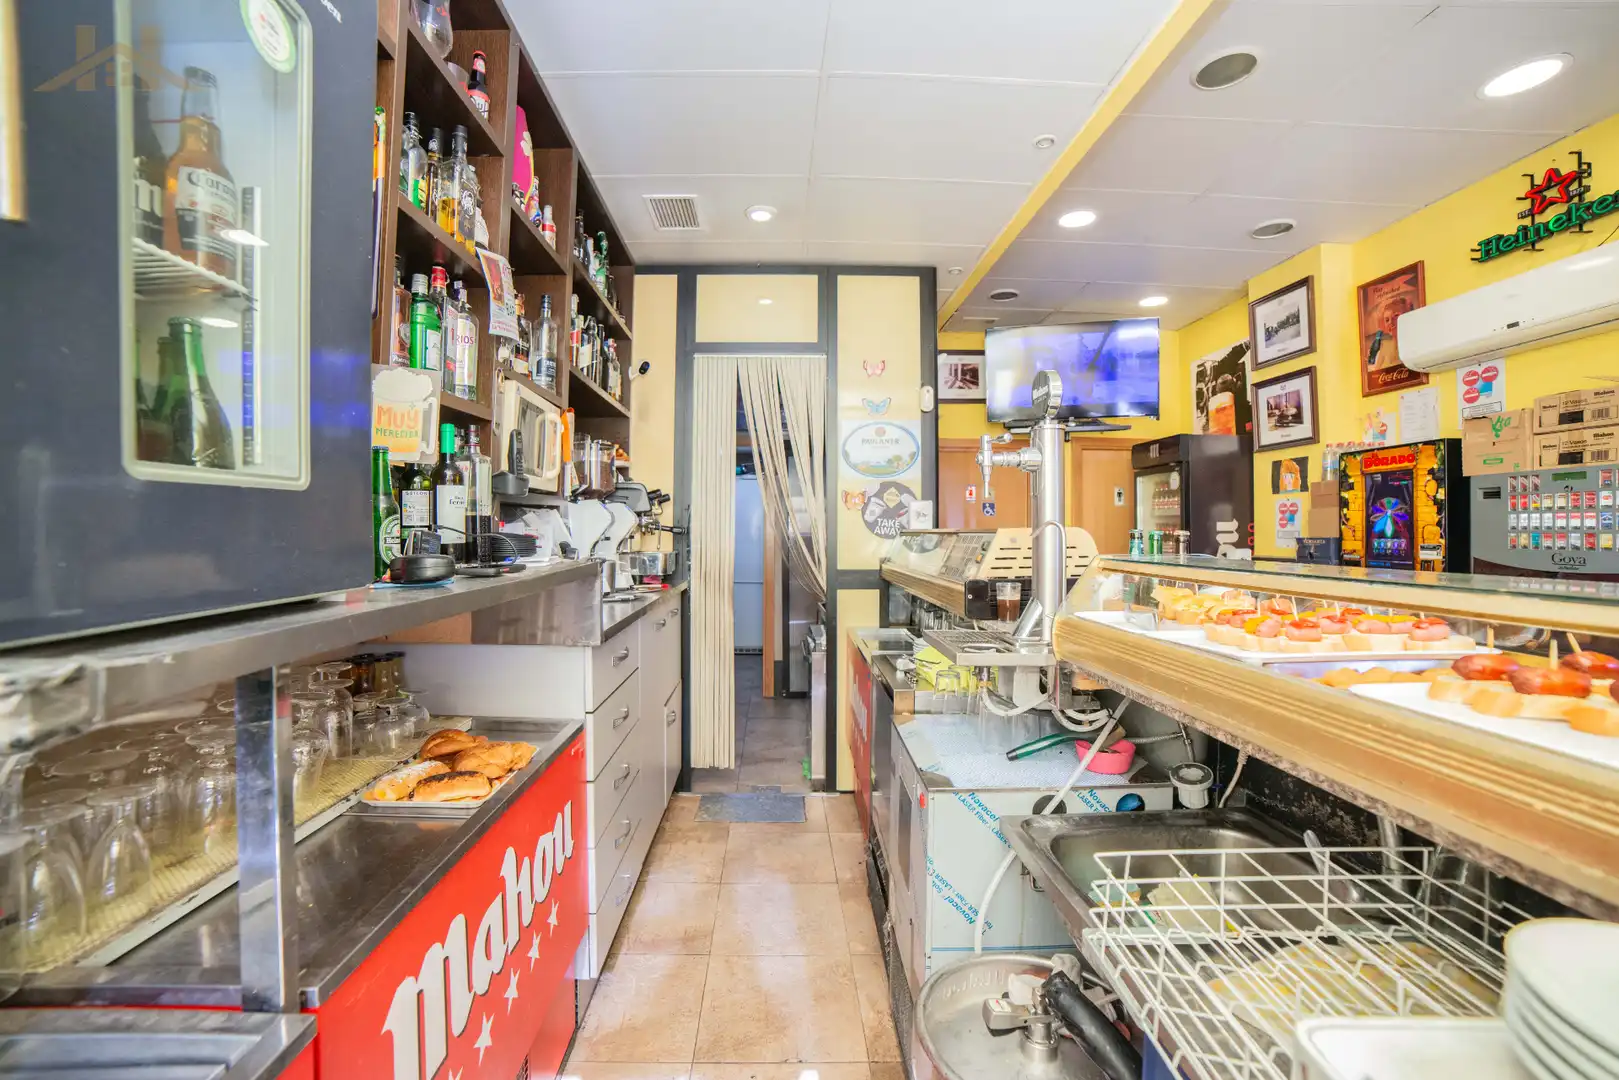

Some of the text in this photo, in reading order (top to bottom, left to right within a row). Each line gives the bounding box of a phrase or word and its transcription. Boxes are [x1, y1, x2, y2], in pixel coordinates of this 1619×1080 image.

[1477, 190, 1619, 262] Heineke
[861, 437, 901, 446] PAULANER
[1363, 453, 1416, 469] DORADO
[873, 526, 901, 537] AWAY
[877, 518, 901, 529] TAKE
[1551, 552, 1587, 566] Goya
[968, 791, 1000, 822] Novacel
[1088, 788, 1113, 813] Novac
[943, 895, 976, 925] Novacel
[381, 799, 575, 1080] Mahou
